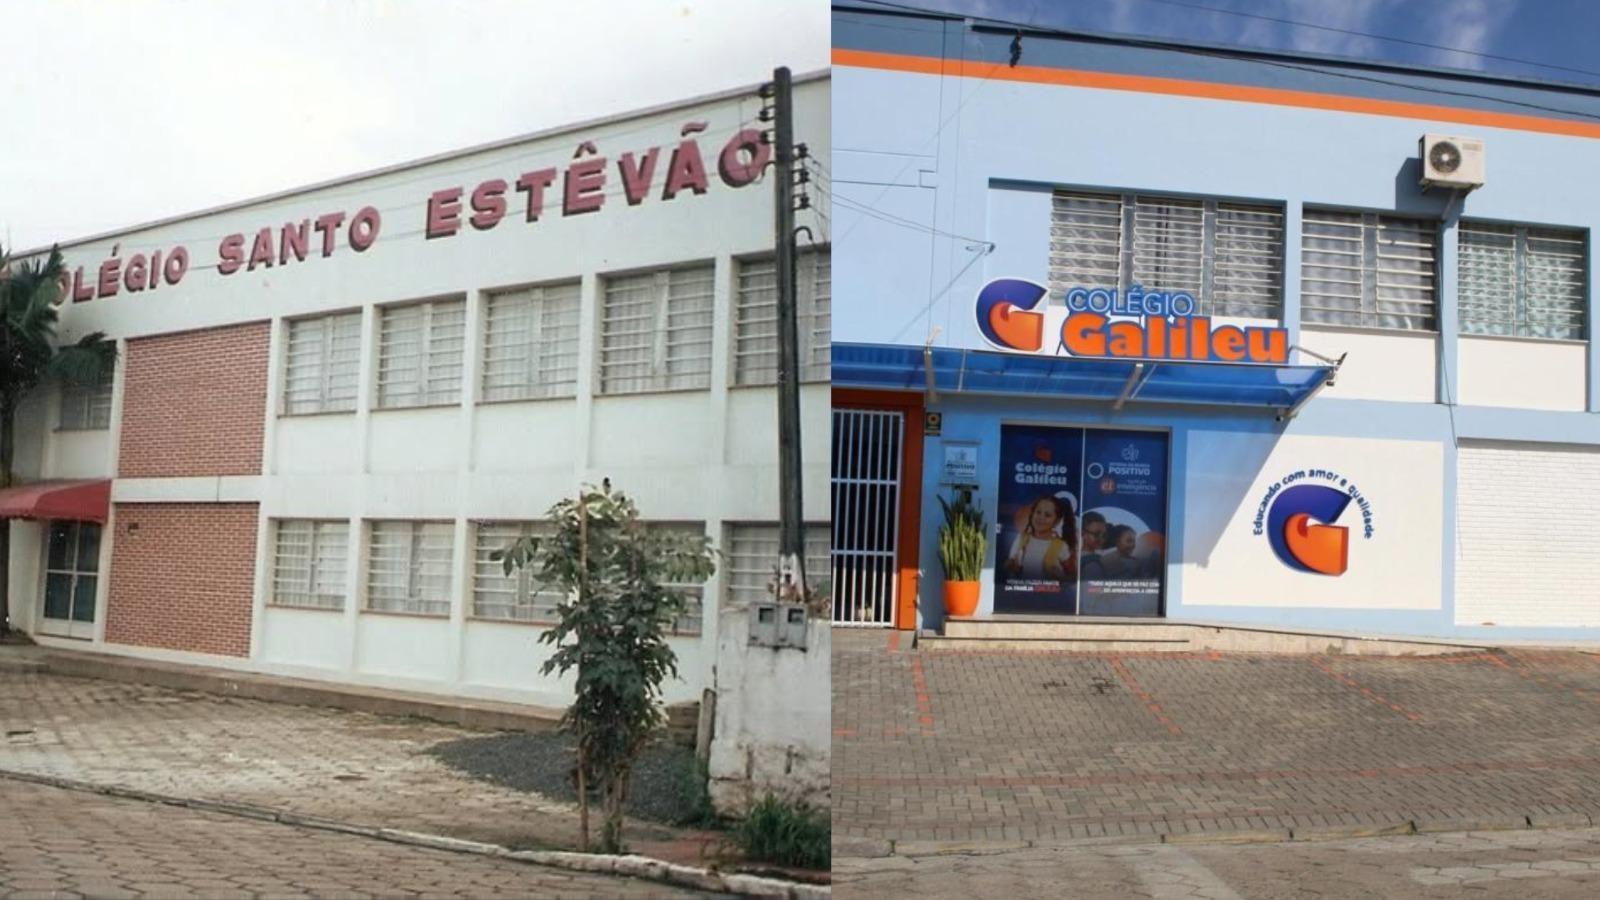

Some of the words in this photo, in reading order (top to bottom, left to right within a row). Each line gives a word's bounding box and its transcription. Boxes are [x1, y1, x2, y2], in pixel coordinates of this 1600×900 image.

[51, 243, 189, 305] OLÉGIO
[217, 205, 382, 275] SANTO
[425, 121, 773, 239] ESTÊVÃO
[1067, 285, 1194, 316] COLÉGIO
[1061, 312, 1289, 362] Galileu
[1014, 473, 1068, 485] Galileu
[1015, 461, 1068, 475] Colégio
[1108, 466, 1151, 476] POSITIVO
[1252, 481, 1282, 536] Educando
[1282, 469, 1306, 485] com
[1308, 469, 1339, 482] amor
[1340, 478, 1348, 487] e
[1347, 485, 1375, 539] qualidade
